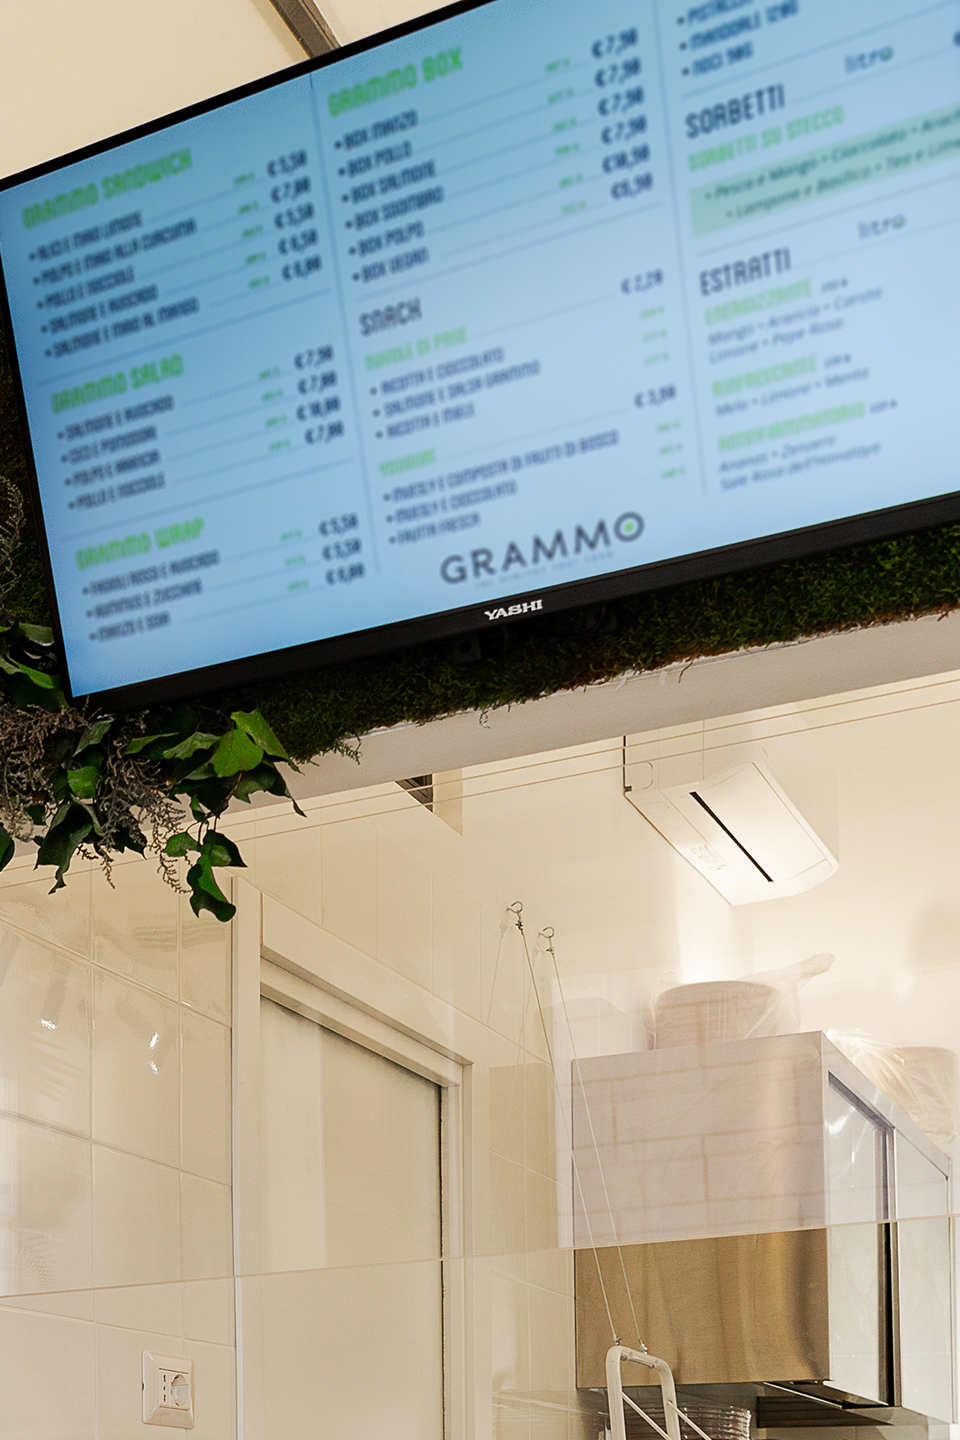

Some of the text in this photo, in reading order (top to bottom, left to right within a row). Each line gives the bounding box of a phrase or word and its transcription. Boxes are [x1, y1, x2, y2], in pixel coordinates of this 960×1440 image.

[842, 39, 895, 76] litro
[326, 44, 465, 119] GRAMMO BOX
[683, 80, 786, 141] SORBETTI
[342, 125, 370, 151] BOX
[687, 131, 758, 174] SORBETTI
[346, 153, 374, 178] BOX
[20, 144, 194, 231] GRAMMO SANDWICH
[350, 179, 377, 204] BOX
[353, 206, 381, 231] BOX
[357, 232, 384, 257] BOX
[360, 258, 388, 283] BOX
[698, 244, 792, 297] ESTRATTI
[359, 295, 424, 337] SNACK
[49, 351, 186, 416] GRAMMO SALAD
[74, 515, 207, 571] GRAMMO WRAP
[438, 507, 646, 587] GRAMMO
[484, 599, 543, 620] YASHI
